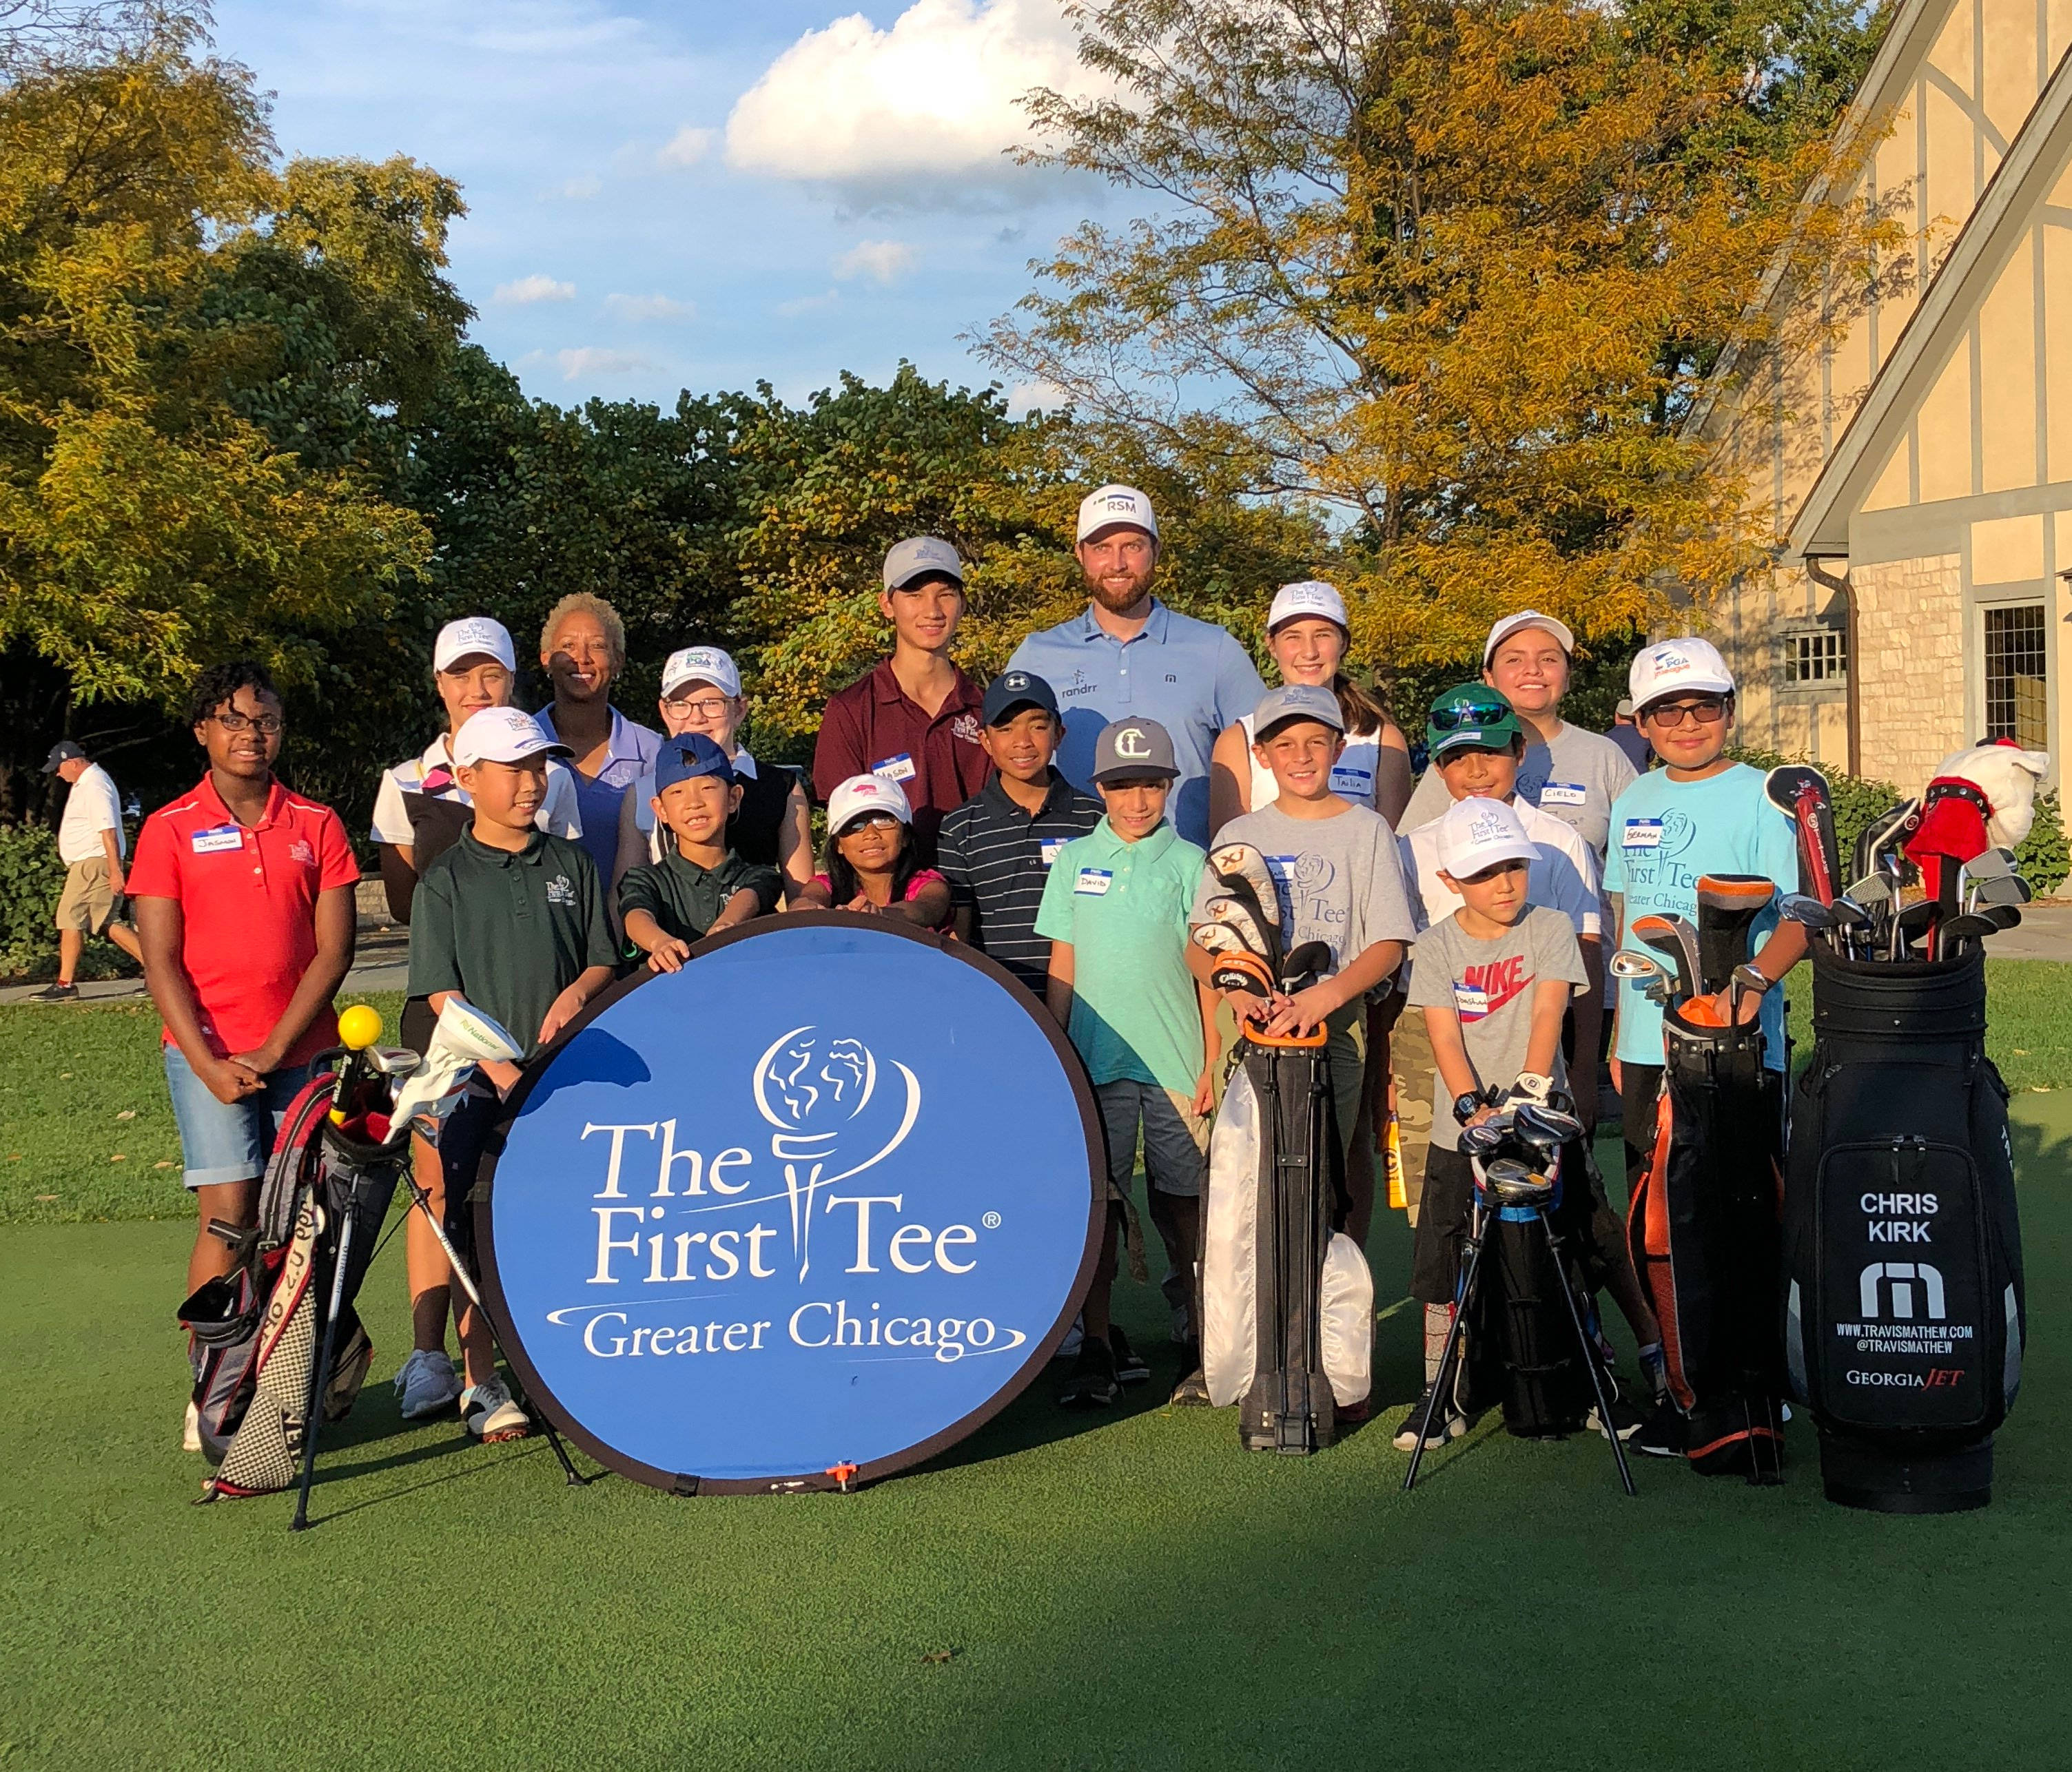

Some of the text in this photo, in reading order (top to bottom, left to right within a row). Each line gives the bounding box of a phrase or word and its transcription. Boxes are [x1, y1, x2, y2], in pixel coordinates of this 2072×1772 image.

[1107, 501, 1136, 513] RSM
[1062, 683, 1097, 698] randrr
[1080, 877, 1106, 887] DAVID
[1309, 898, 1346, 923] Tee
[1654, 893, 1697, 916] Chicag
[1465, 955, 1524, 994] NIKE
[581, 1118, 752, 1197] The
[1860, 1193, 1939, 1215] CHRIS
[1869, 1220, 1932, 1242] KIRK
[586, 1206, 777, 1283] First
[584, 1300, 996, 1363] Greater Chicago
[1836, 1323, 1973, 1339] WWW.TRAVISMATHEW.COM
[1856, 1339, 1953, 1354] @TRAVISMATHEW
